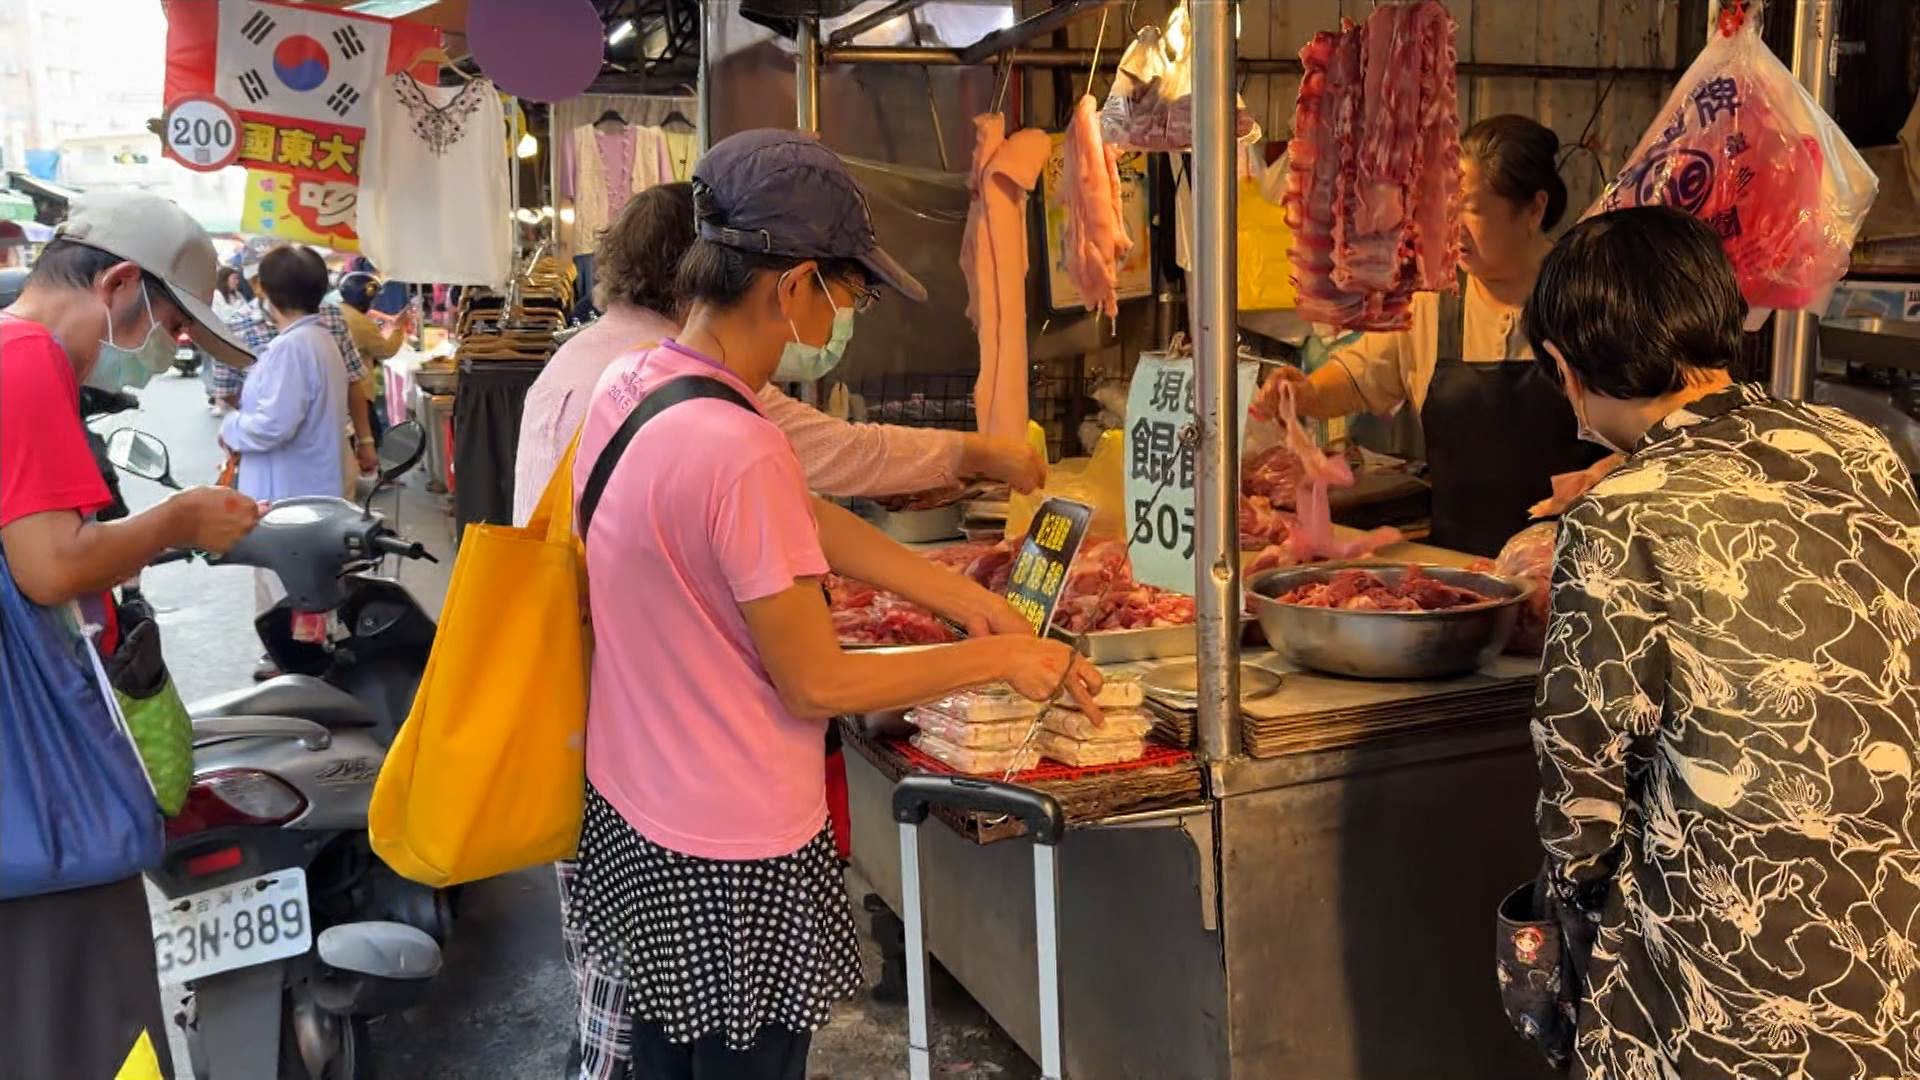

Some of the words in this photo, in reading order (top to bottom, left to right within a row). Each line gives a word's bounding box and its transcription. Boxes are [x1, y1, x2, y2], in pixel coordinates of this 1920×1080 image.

[174, 117, 232, 148] 200
[240, 122, 366, 176] 國東大
